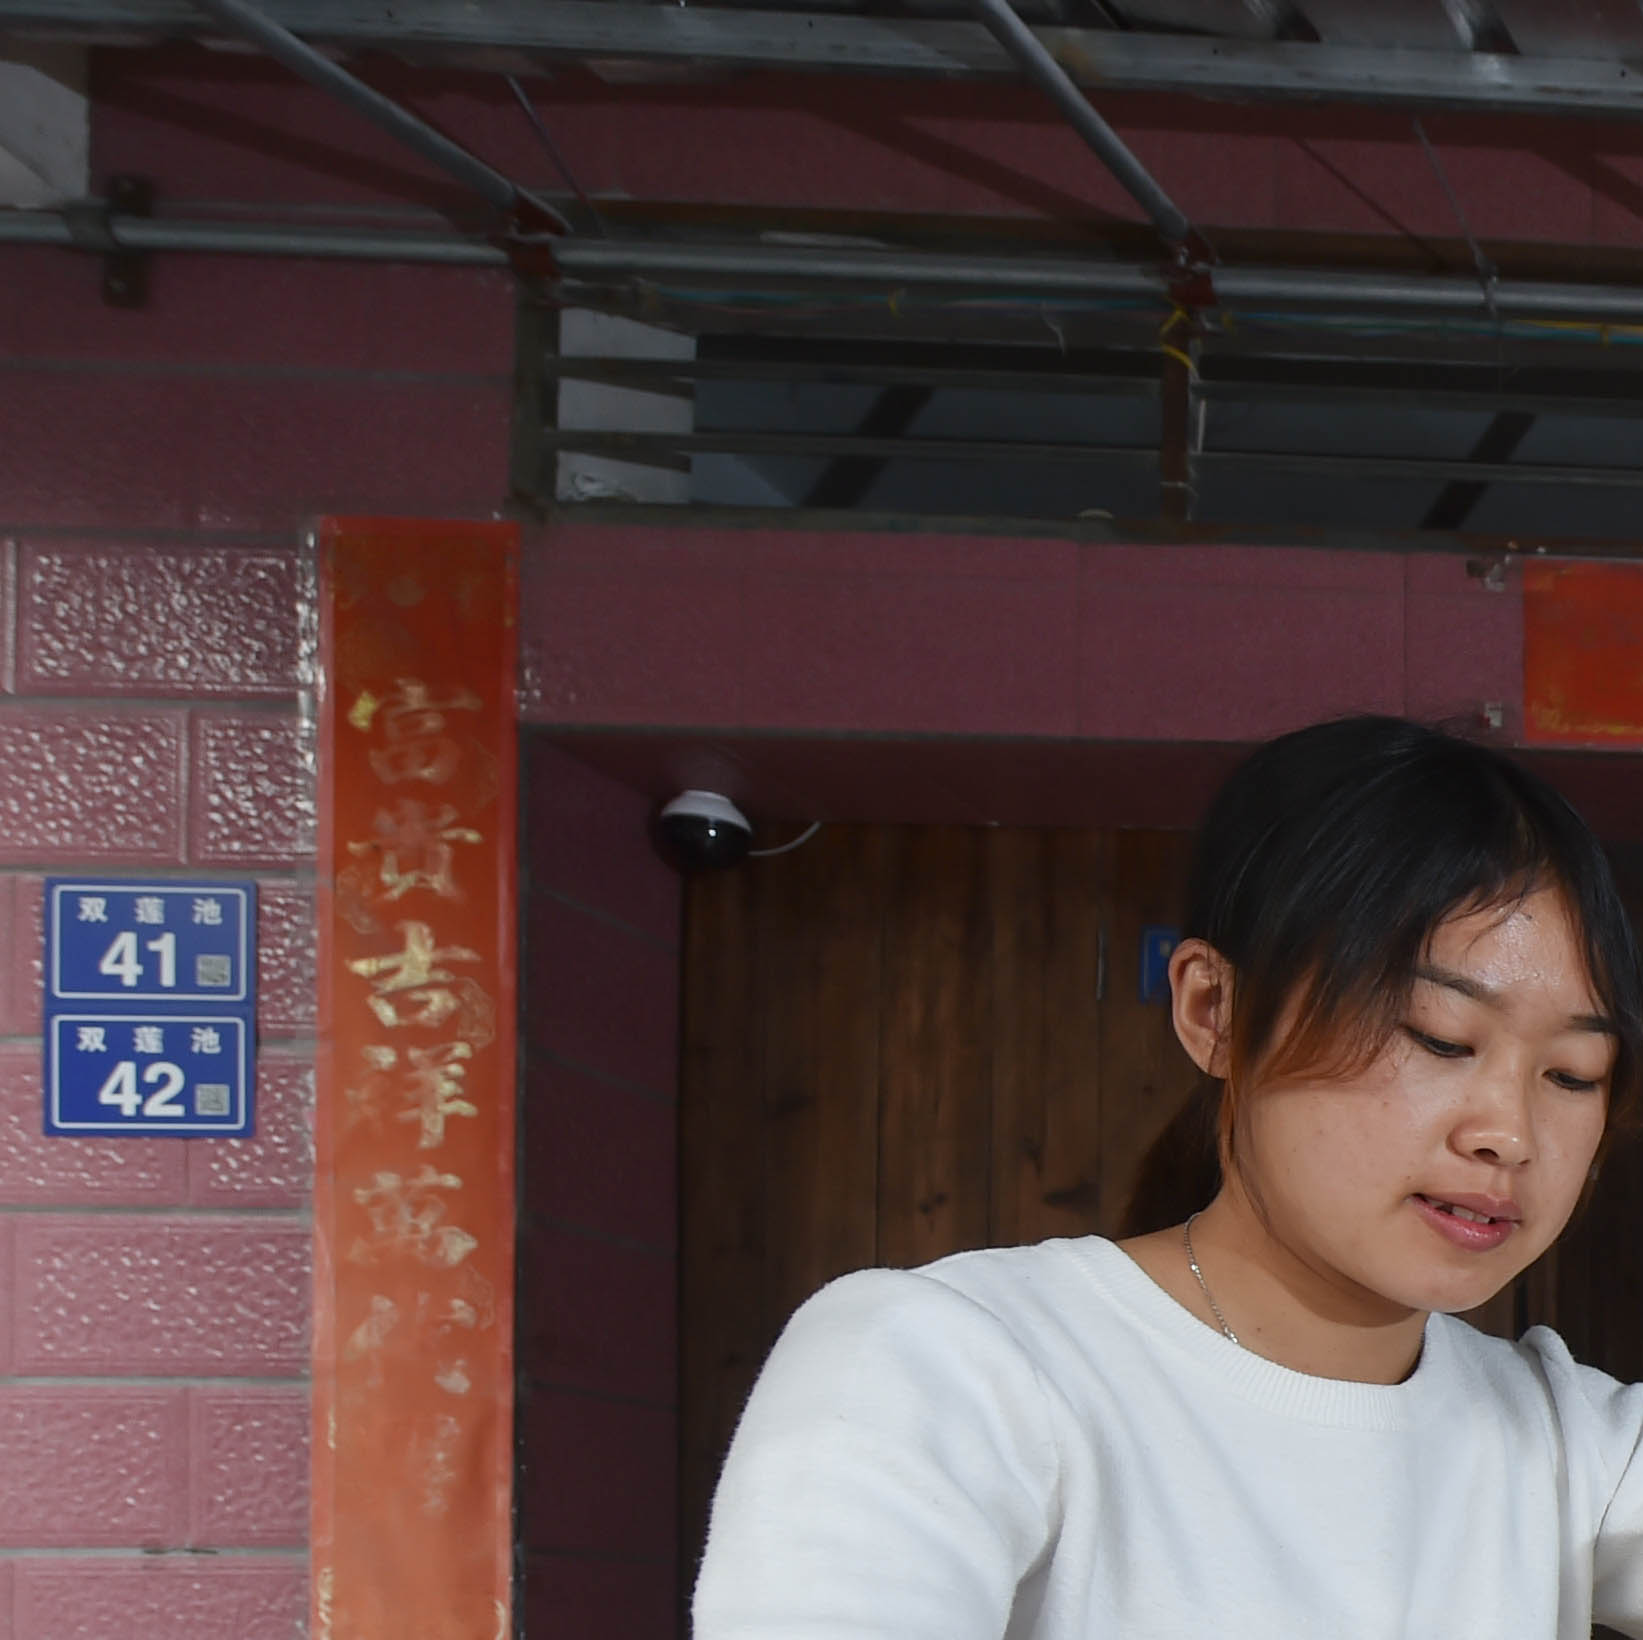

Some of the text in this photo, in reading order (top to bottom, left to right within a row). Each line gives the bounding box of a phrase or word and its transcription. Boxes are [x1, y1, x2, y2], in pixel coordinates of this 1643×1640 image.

[77, 896, 223, 925] 双莲池
[100, 931, 176, 987] 41
[76, 1026, 222, 1054] 双莲池
[99, 1061, 186, 1117] 42
